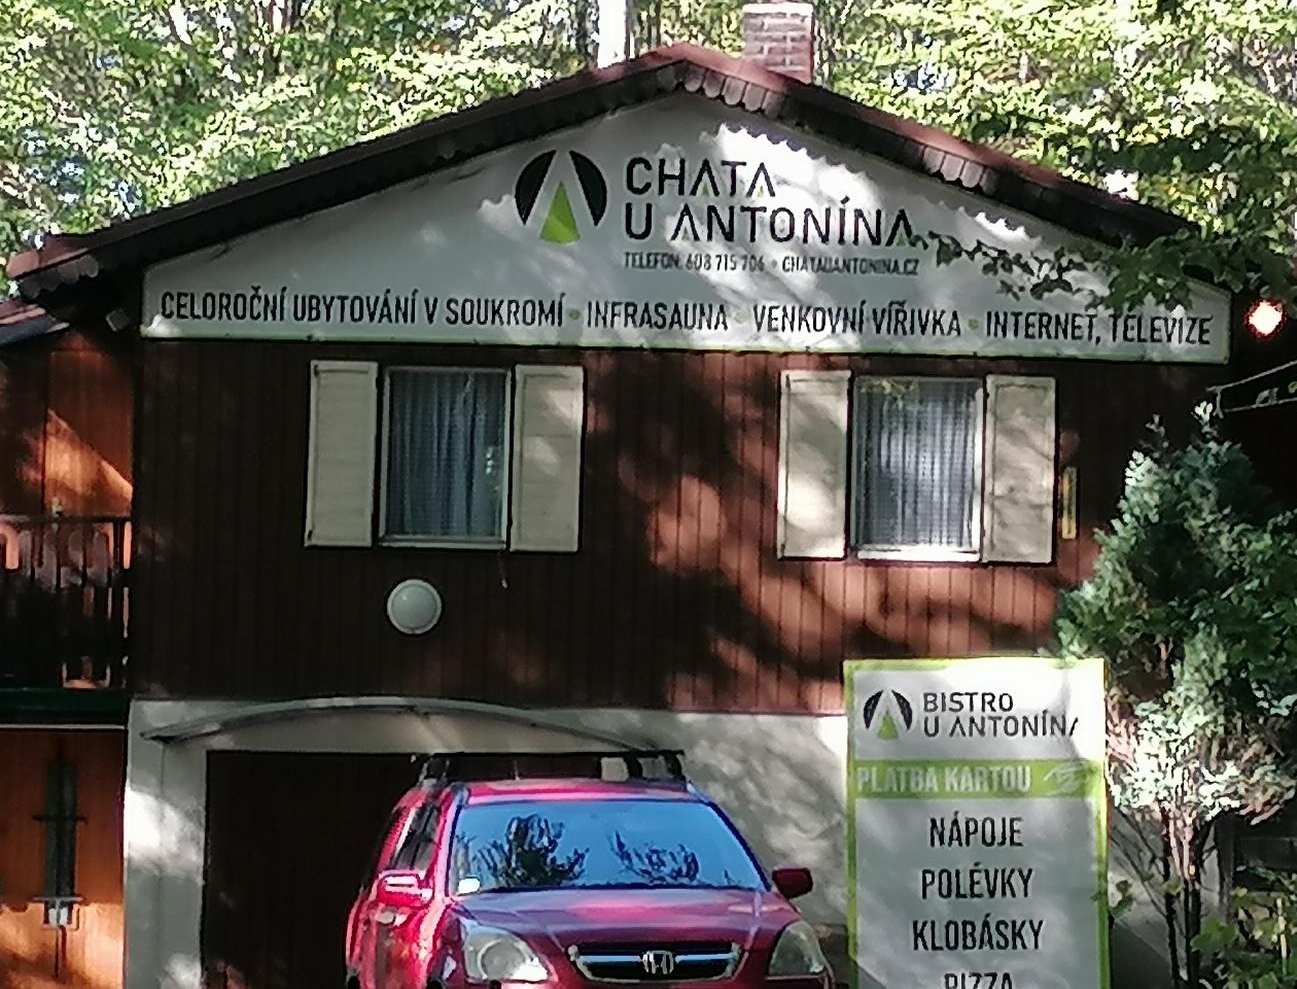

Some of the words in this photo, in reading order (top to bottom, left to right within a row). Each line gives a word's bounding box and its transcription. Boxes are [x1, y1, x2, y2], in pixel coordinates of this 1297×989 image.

[625, 156, 776, 197] CHATA
[625, 202, 653, 241] U
[670, 195, 919, 247] ANTONÍNA
[685, 252, 712, 271] 608
[716, 253, 738, 272] 715
[160, 285, 288, 321] CELOROČNÍ
[293, 288, 419, 324] UBYTOVÁNÍ
[423, 296, 439, 325] V
[444, 292, 567, 328] SOUKROMÍ
[586, 300, 729, 331] INFRASAUNA
[752, 299, 868, 335] VENKOVNÍ
[872, 299, 962, 337] VÍŘIVKA
[985, 310, 1102, 346] INTERNET,
[1109, 313, 1214, 345] TELEVIZE
[923, 692, 1014, 713] BISTRO
[923, 715, 940, 738] U
[856, 766, 939, 793] PLATBA
[944, 765, 1032, 793] KARTOU
[929, 811, 1024, 848] NÁPOJE
[921, 862, 1034, 900] POLÉVKY
[912, 913, 1044, 951] KLOBÁSKY
